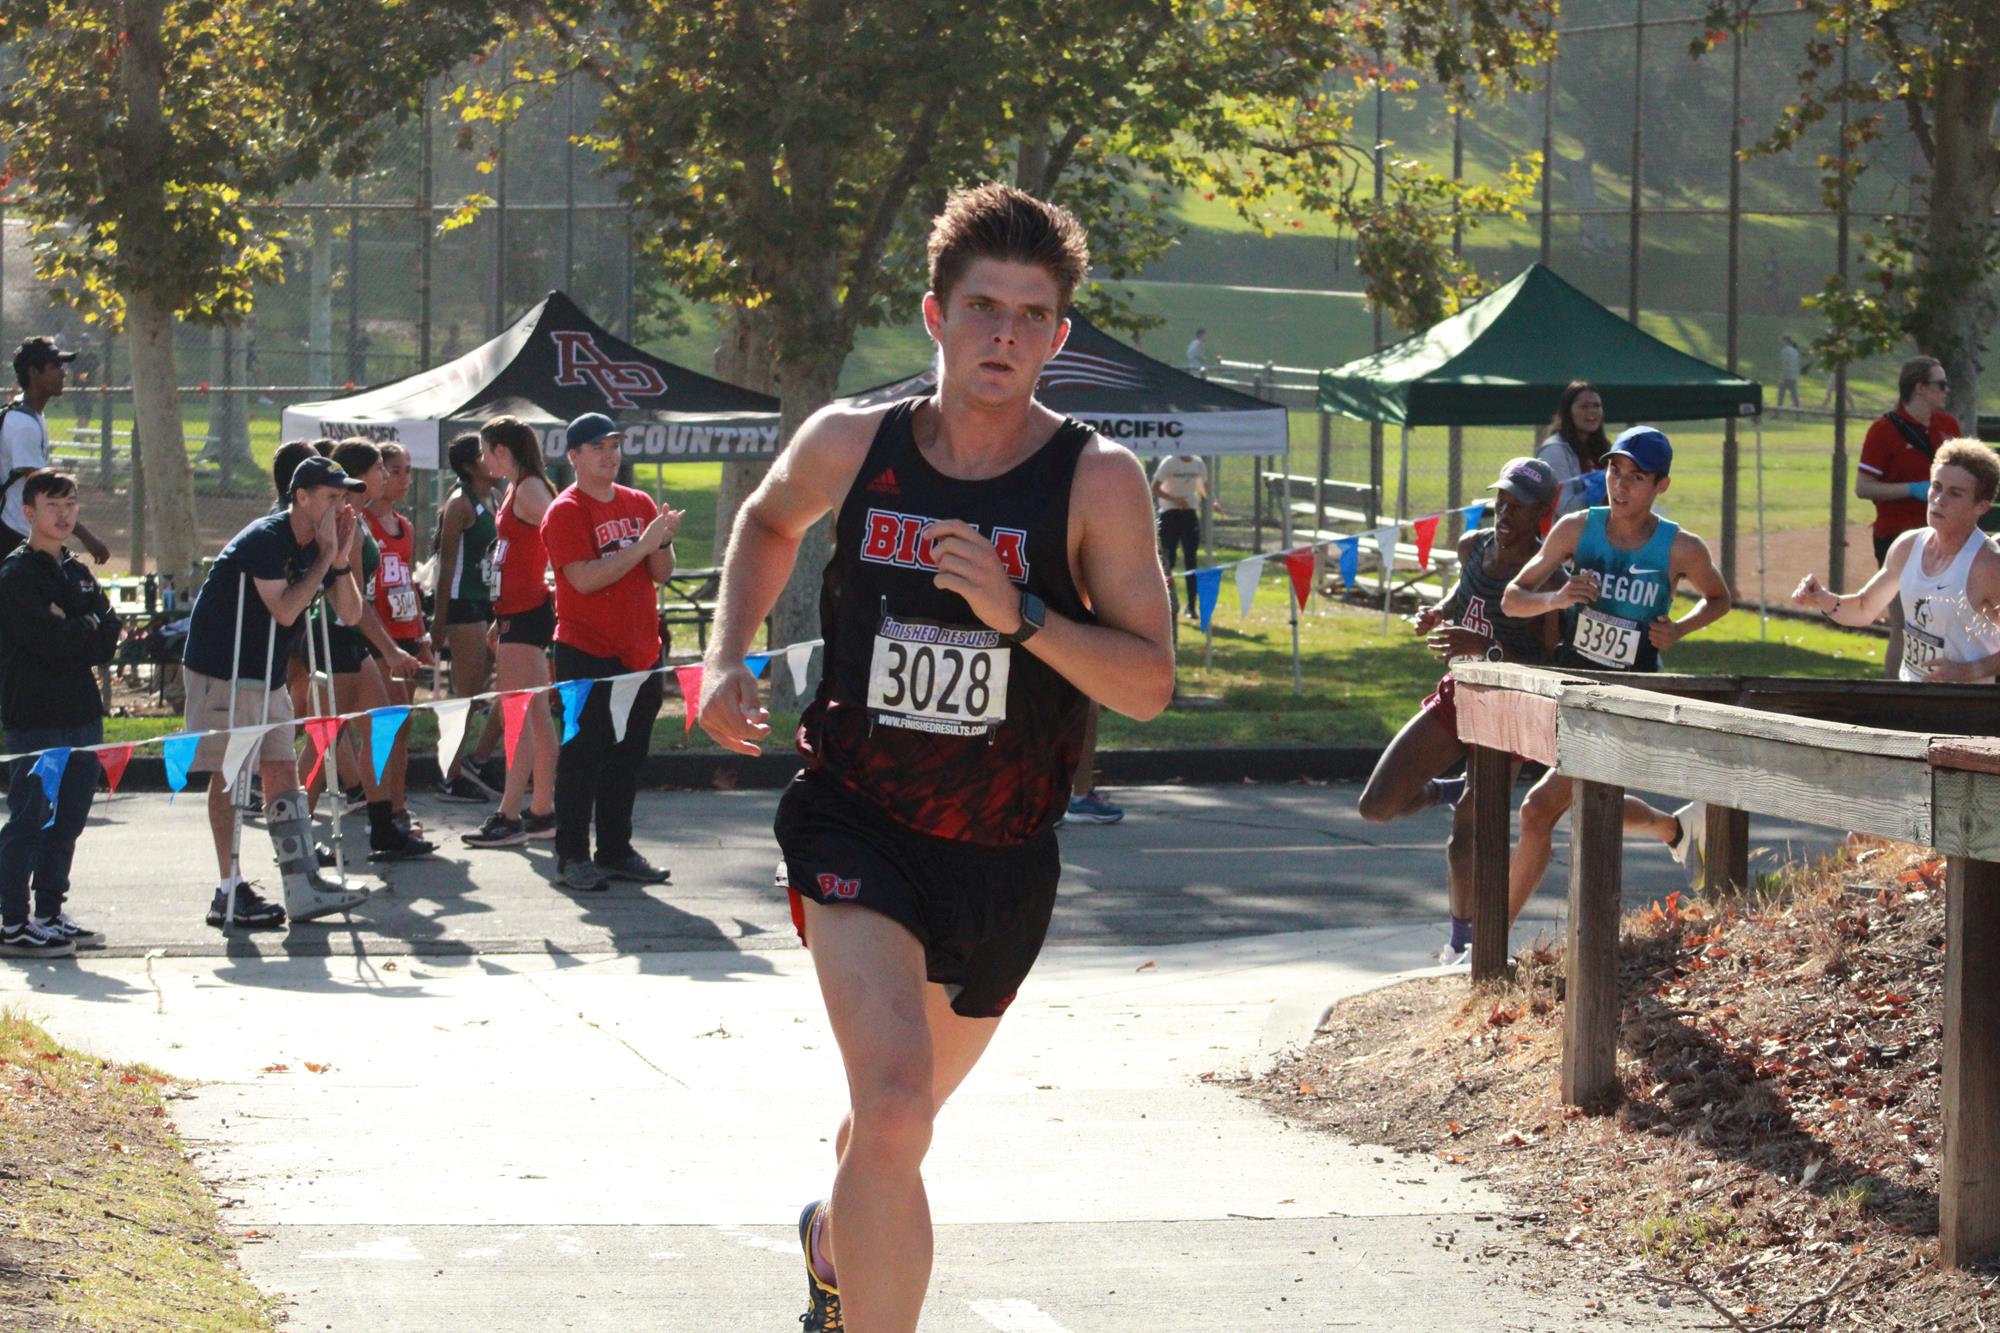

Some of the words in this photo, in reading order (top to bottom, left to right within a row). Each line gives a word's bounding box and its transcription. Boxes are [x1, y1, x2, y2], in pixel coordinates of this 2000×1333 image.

[622, 423, 780, 456] COUNTRY
[1082, 418, 1184, 438] PACIFIC
[860, 507, 1030, 584] BIA
[1580, 568, 1660, 608] EGON
[880, 616, 940, 643] FINISHED
[937, 628, 1000, 649] RESULTS
[1579, 618, 1632, 660] 3395
[882, 642, 992, 717] 3028
[878, 713, 989, 737] WWW.FINISHEDRESULTS.COM
[816, 872, 862, 899] BU
